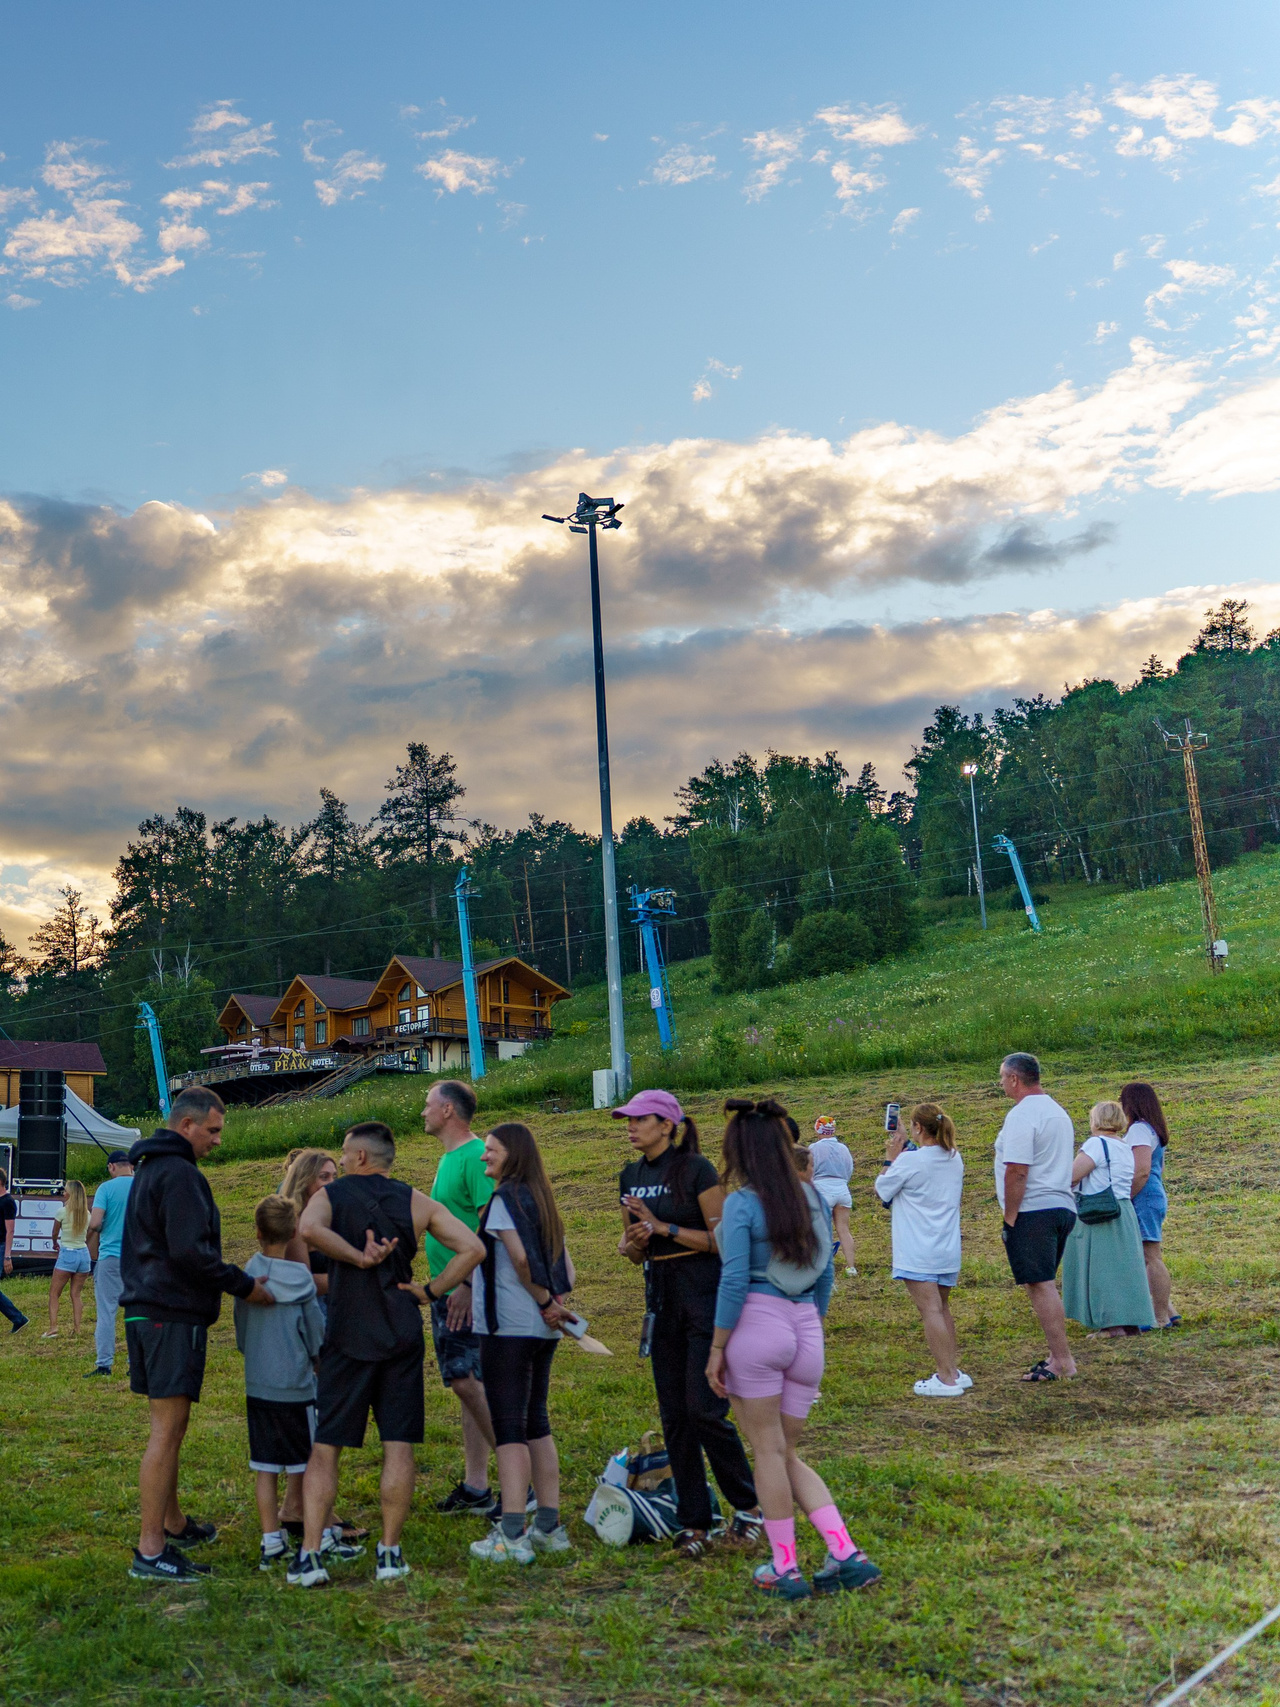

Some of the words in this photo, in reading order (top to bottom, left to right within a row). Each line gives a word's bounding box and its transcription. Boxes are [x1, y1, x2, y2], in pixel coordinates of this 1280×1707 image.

[250, 1063, 270, 1071] ОТЕЛЬ
[274, 1058, 307, 1072] PEAK
[312, 1058, 333, 1066] HOTEL
[155, 1561, 177, 1574] HOKA
